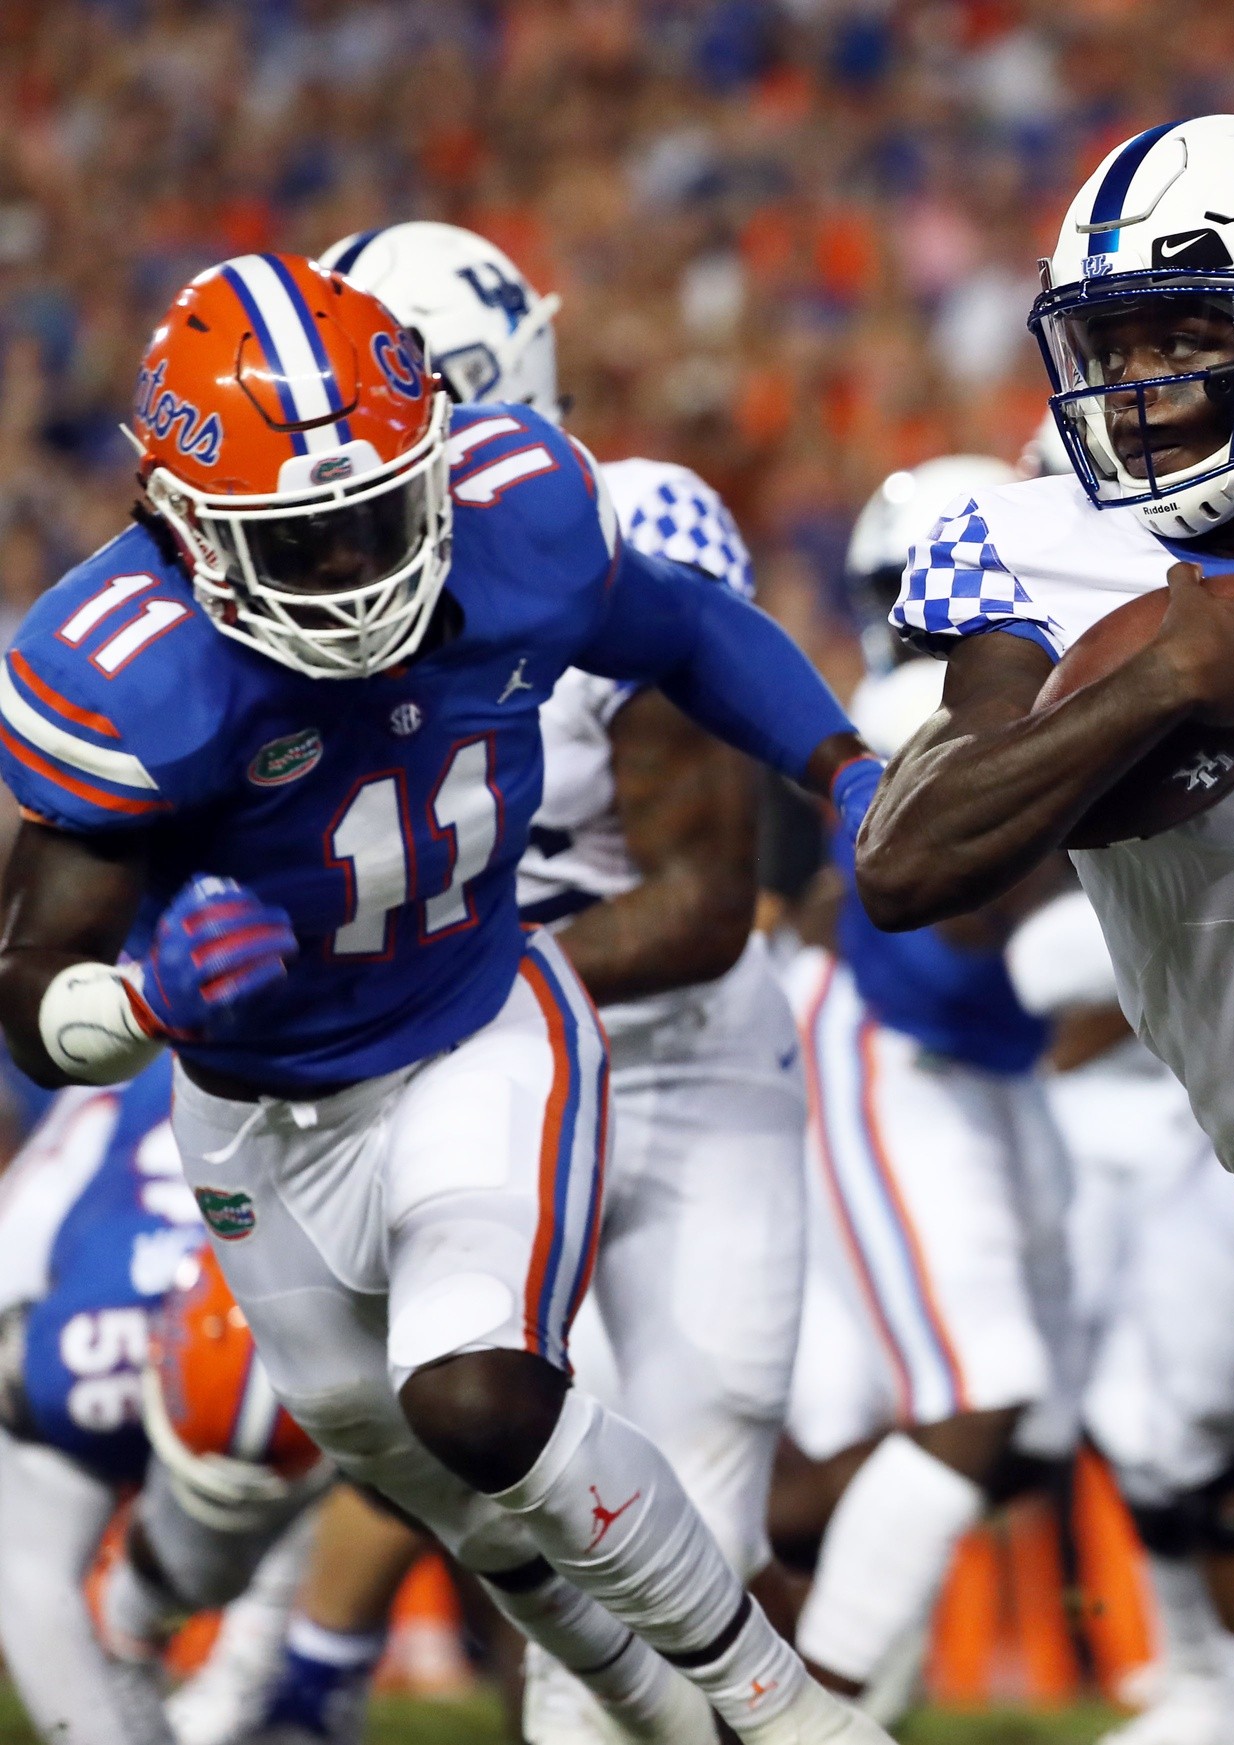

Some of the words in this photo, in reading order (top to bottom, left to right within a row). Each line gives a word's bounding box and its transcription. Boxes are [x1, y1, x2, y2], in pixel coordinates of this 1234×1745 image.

[446, 410, 560, 509] 11
[55, 571, 194, 681] 11
[325, 736, 509, 962] 11
